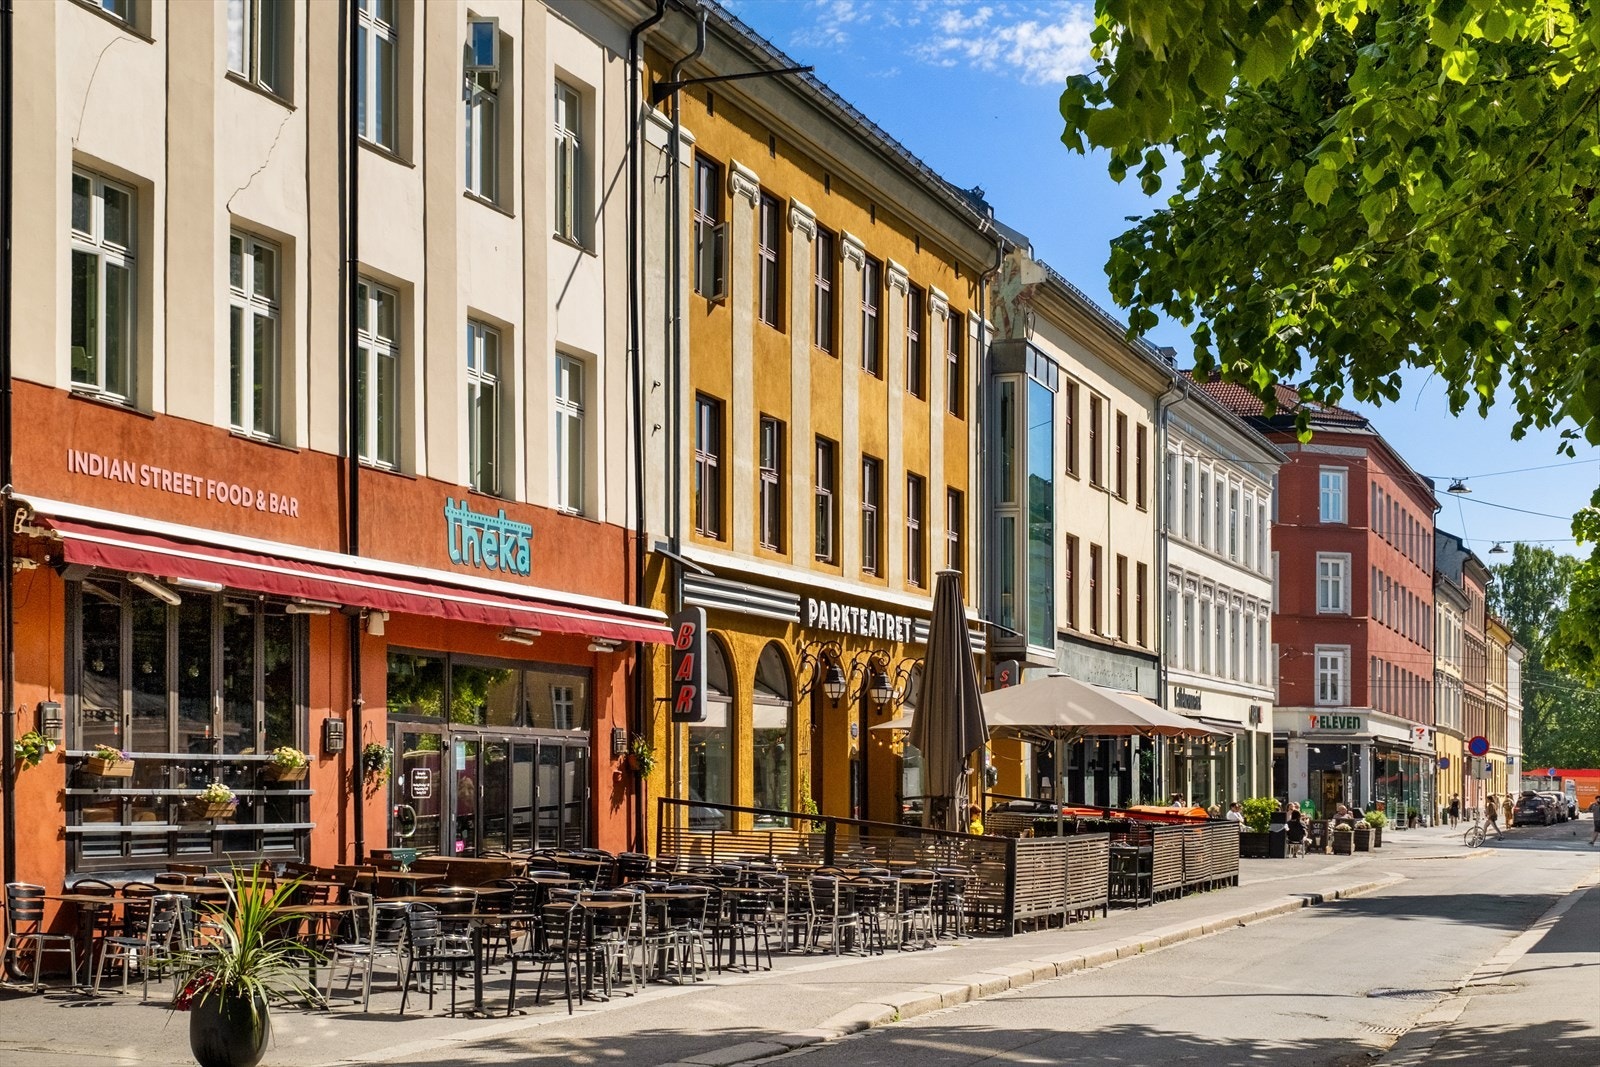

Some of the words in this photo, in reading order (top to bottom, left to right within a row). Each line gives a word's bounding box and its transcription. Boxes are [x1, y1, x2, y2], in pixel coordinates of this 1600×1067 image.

[68, 449, 136, 484] INDIAN
[140, 464, 203, 498] STREET
[206, 479, 253, 508] FOOD
[255, 489, 266, 511] &
[269, 492, 299, 518] BAR
[444, 496, 533, 577] theka
[808, 598, 911, 644] PARKTEATRET
[674, 622, 696, 713] BAR
